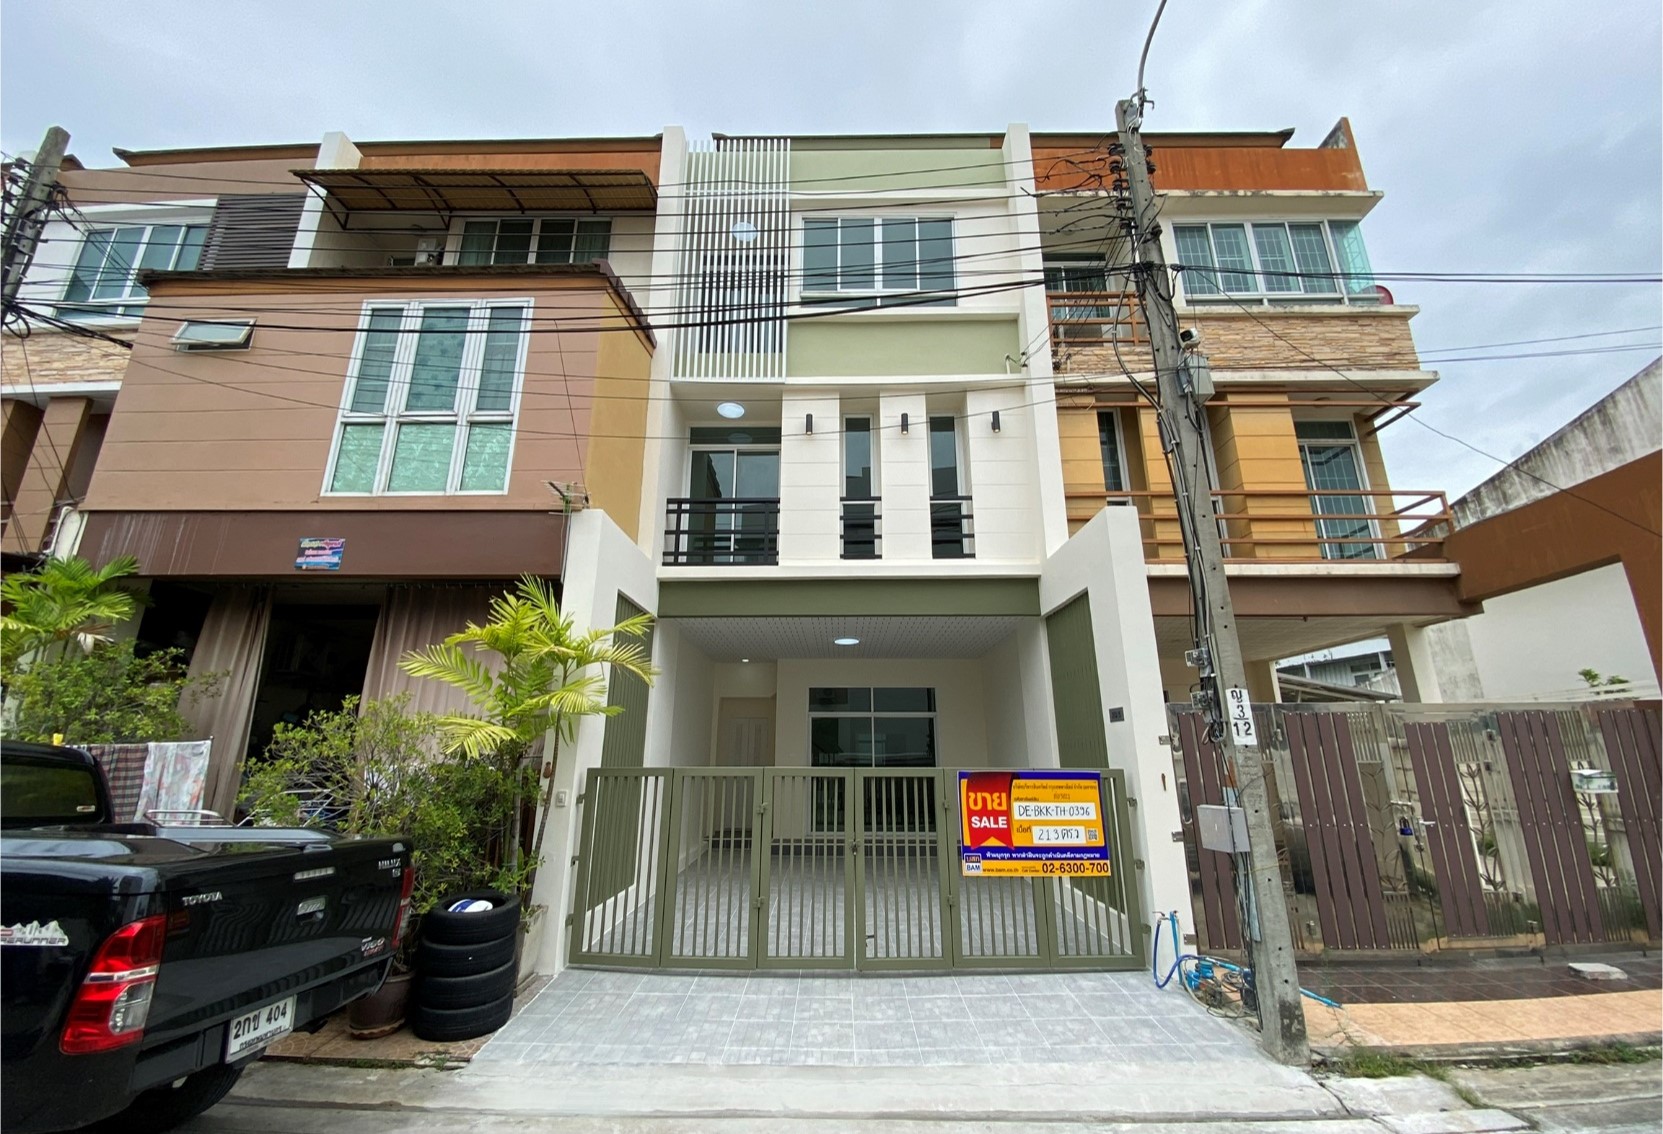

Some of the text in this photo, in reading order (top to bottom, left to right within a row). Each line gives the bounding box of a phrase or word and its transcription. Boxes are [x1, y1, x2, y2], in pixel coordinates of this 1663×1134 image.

[1237, 704, 1246, 718] 3
[1233, 721, 1253, 737] 12
[968, 792, 1007, 811] ขาย
[971, 815, 1007, 828] SALE
[1042, 862, 1109, 874] 02-6300-700
[182, 891, 223, 906] TOYOTA
[266, 1001, 288, 1025] 404
